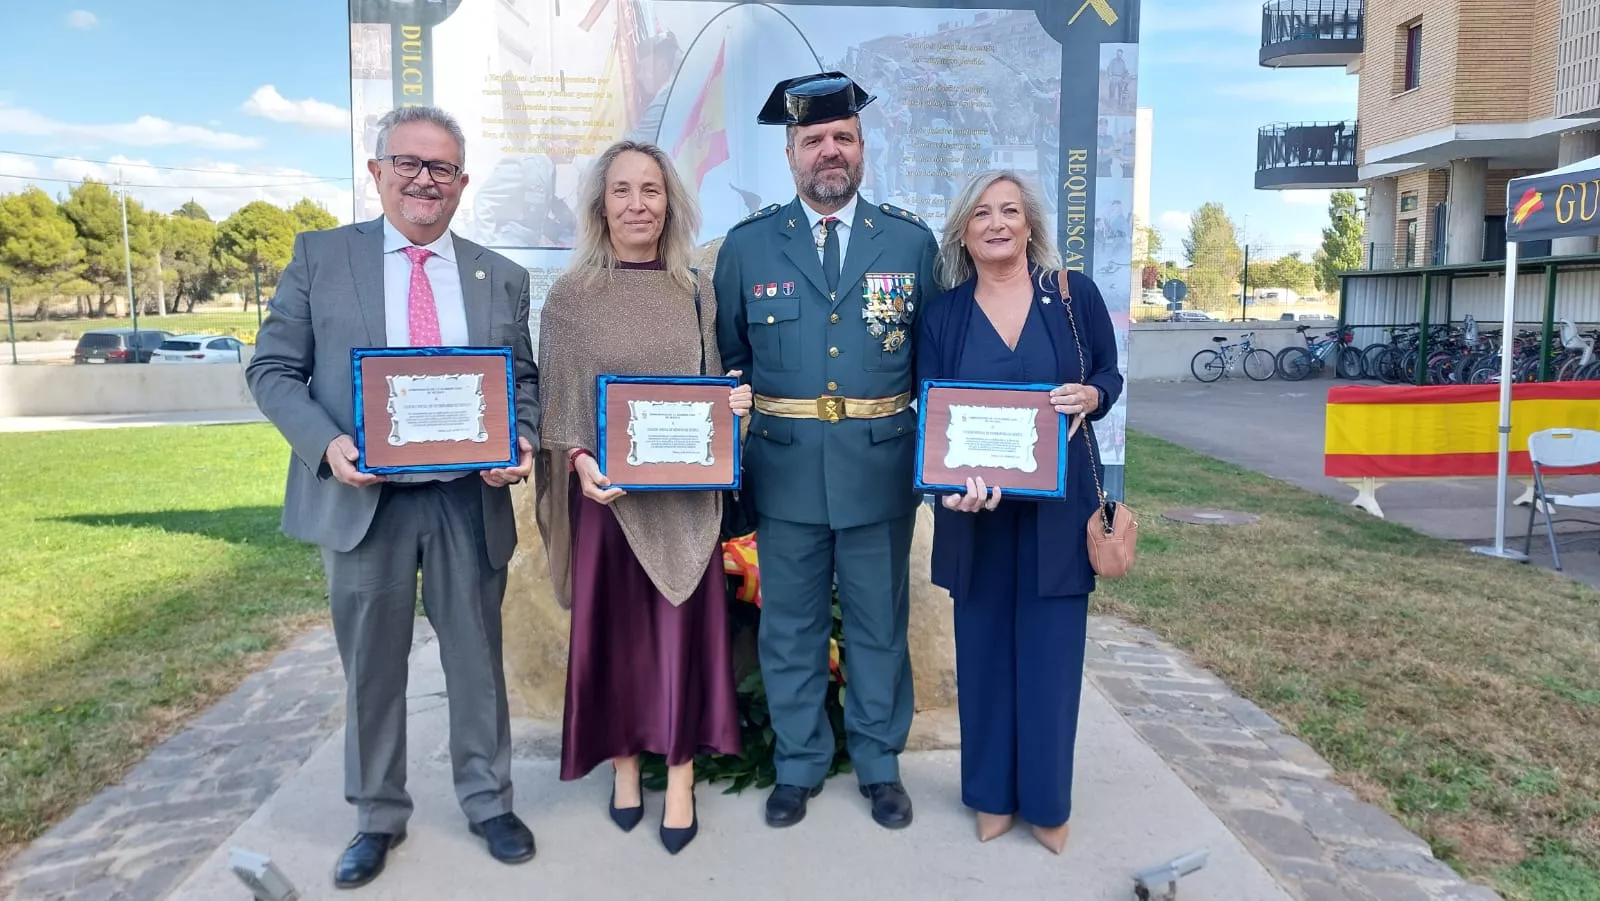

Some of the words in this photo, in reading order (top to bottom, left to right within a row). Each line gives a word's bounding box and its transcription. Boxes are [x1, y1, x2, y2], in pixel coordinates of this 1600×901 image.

[401, 25, 423, 96] DULCE
[1064, 149, 1088, 274] REQUIESCAT
[1555, 180, 1600, 224] GU
